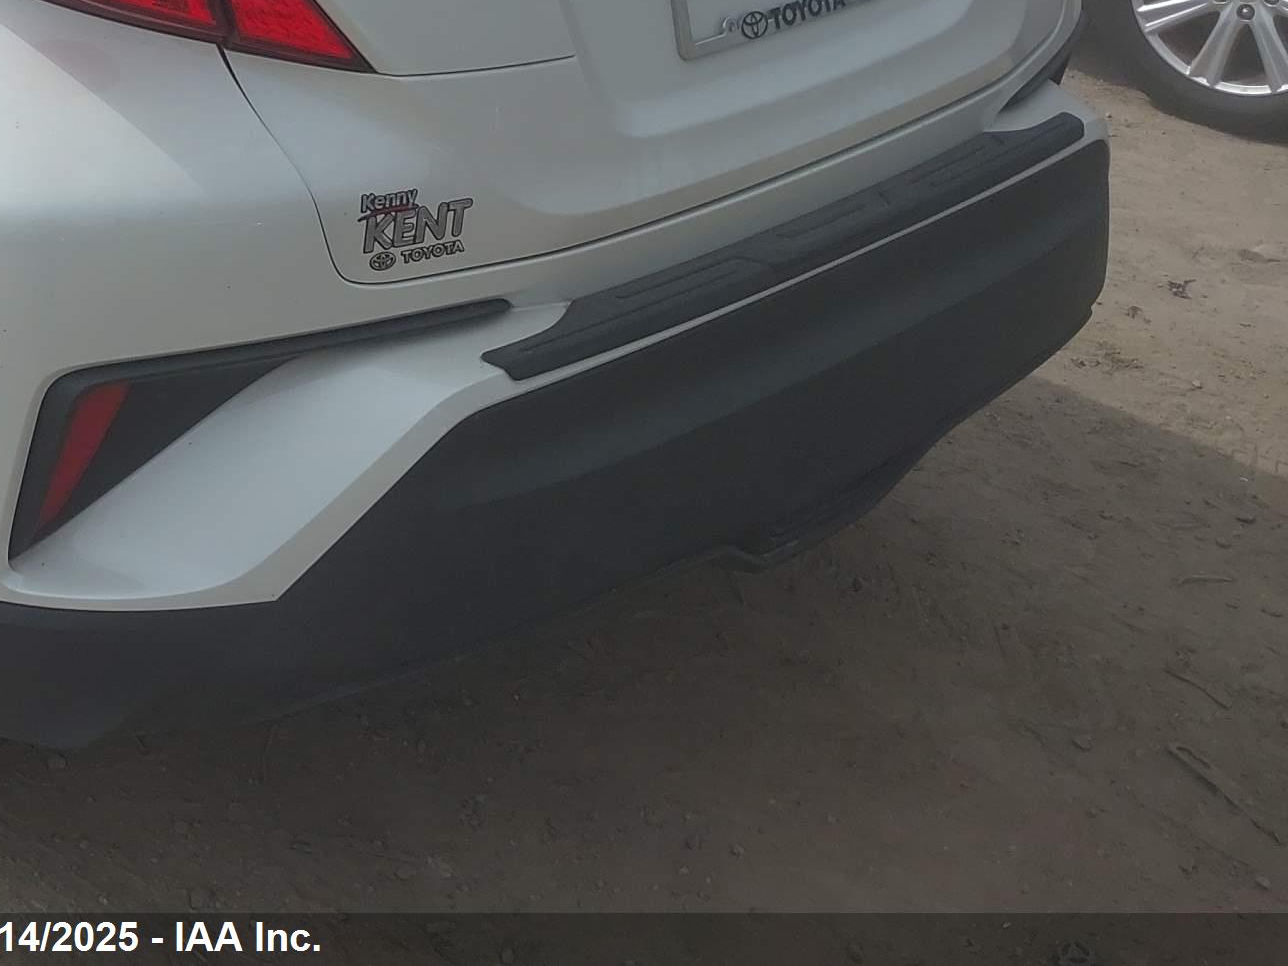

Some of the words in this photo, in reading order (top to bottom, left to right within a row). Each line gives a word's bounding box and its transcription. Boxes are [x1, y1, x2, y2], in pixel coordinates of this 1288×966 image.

[360, 188, 419, 213] Kenny
[363, 197, 474, 254] KENT
[401, 239, 465, 264] TOYOTA
